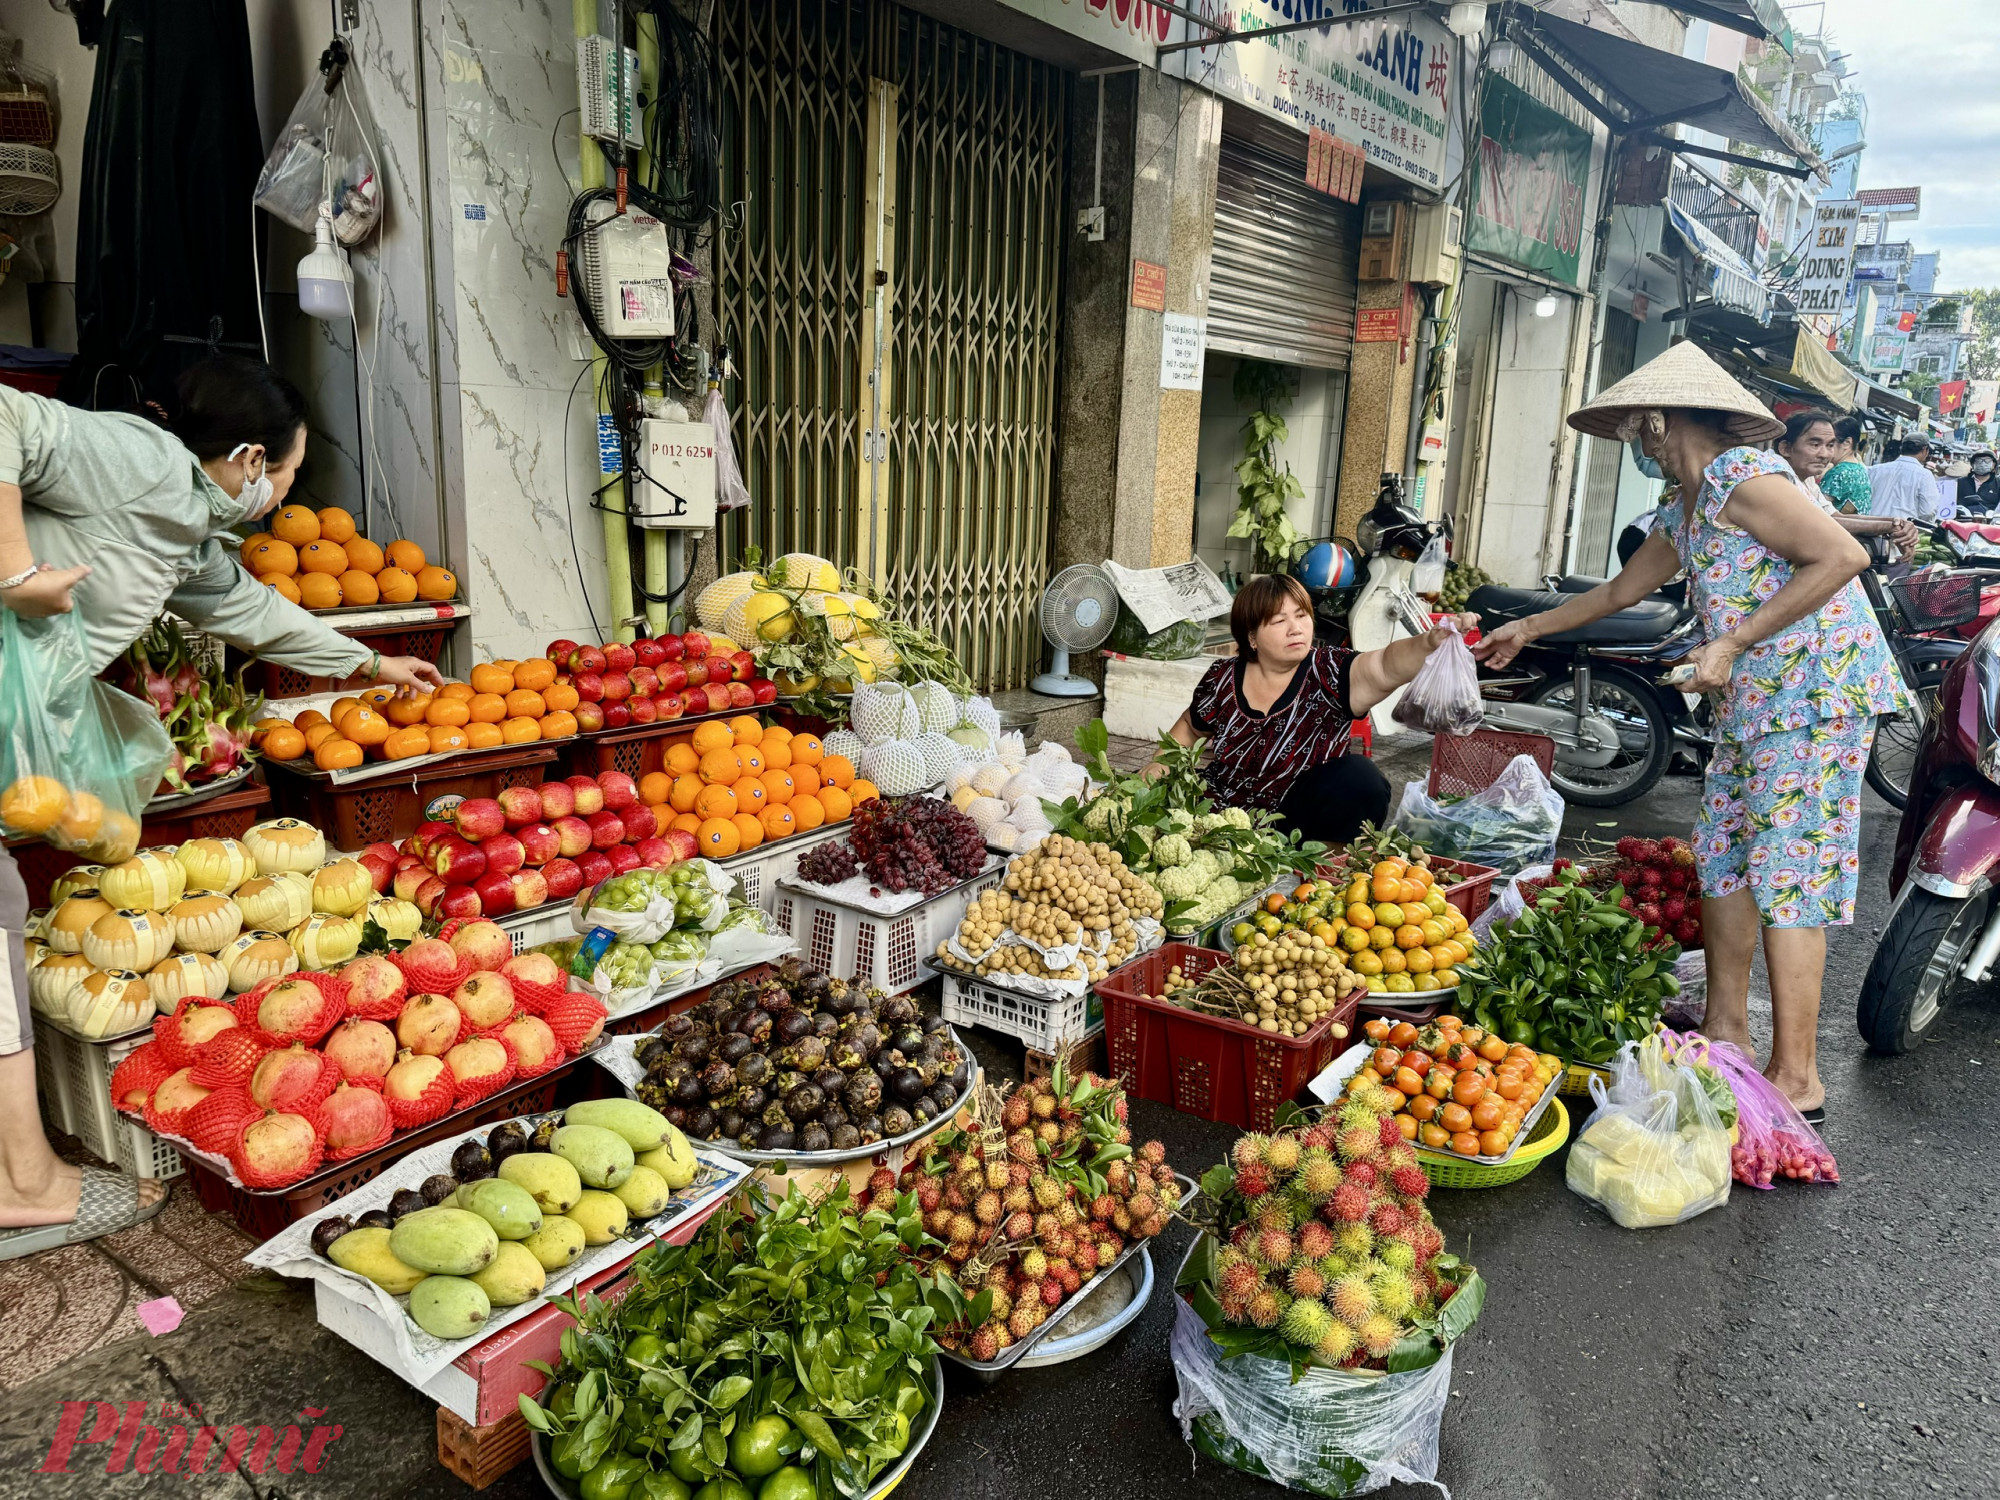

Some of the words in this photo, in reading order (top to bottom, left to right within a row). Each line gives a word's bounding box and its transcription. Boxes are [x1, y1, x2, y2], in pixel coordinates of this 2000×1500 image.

[1425, 43, 1449, 112] 城
[1816, 226, 1848, 247] KIM
[1804, 257, 1845, 279] DUNG
[1799, 283, 1840, 309] PHÁT
[652, 443, 659, 455] P
[662, 445, 682, 457] 012
[480, 1333, 511, 1356] Class
